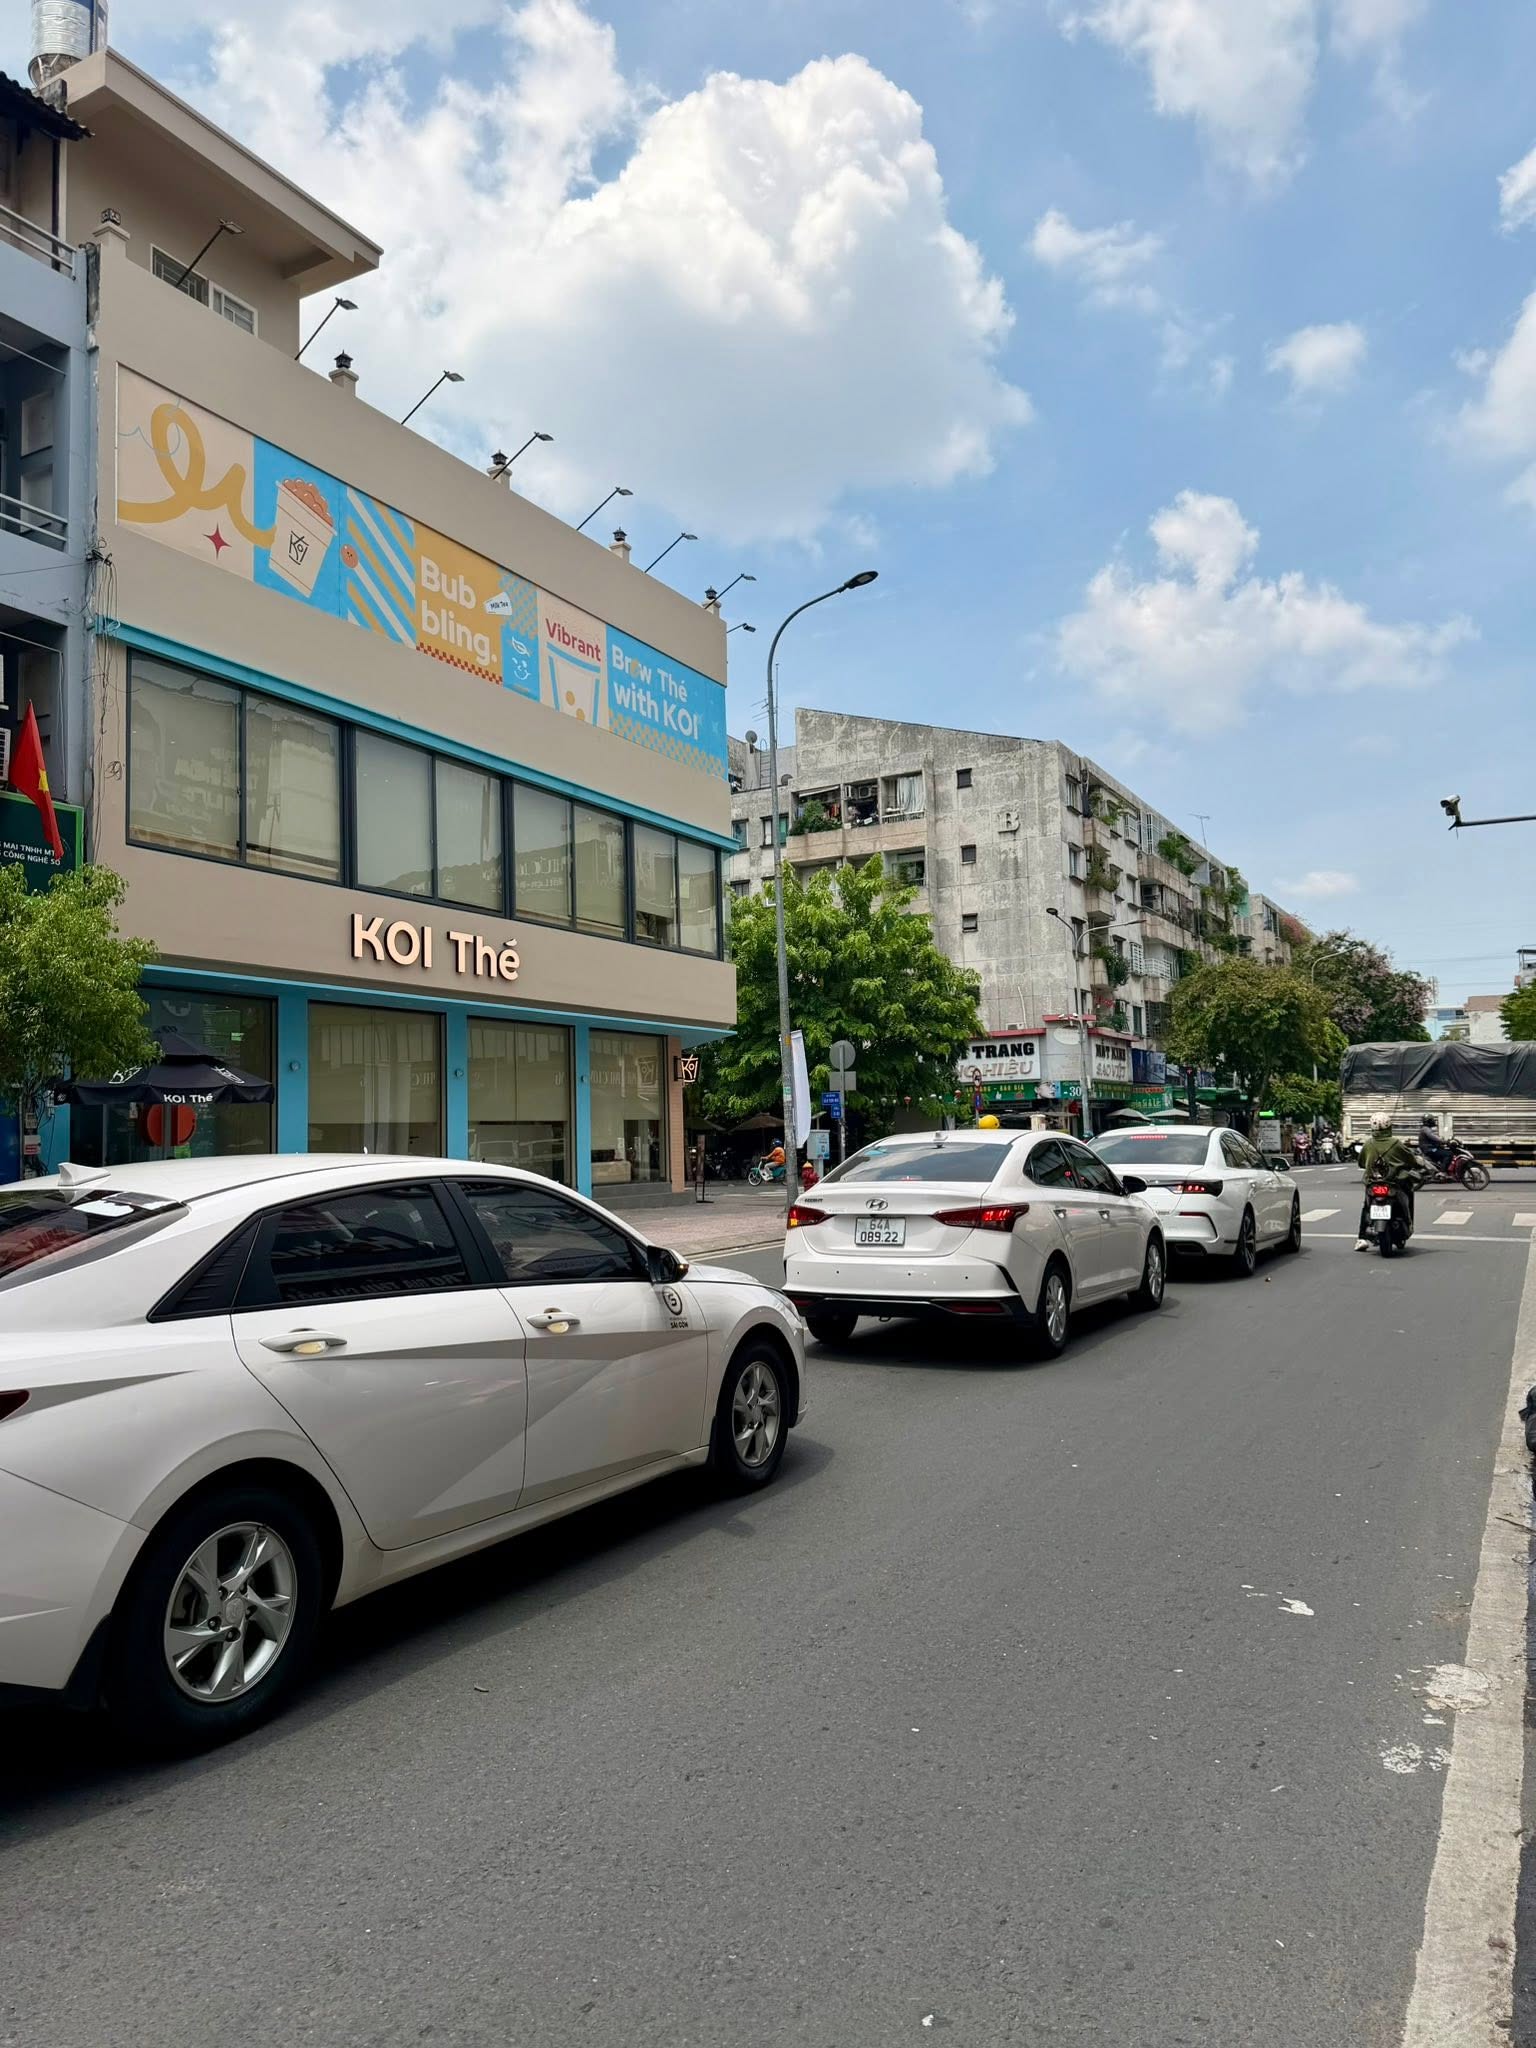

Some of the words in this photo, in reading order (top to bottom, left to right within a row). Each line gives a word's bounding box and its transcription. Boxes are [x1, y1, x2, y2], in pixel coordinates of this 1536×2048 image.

[420, 554, 477, 610] Bub
[421, 599, 498, 666] bling.
[545, 617, 602, 662] Vibrant
[656, 667, 688, 703] Thé
[613, 680, 660, 723] with
[663, 699, 699, 741] KOI
[3, 850, 25, 860] CÔNG
[20, 844, 42, 855] TNHH
[351, 913, 432, 968] KOI
[446, 930, 520, 981] Thé
[972, 1042, 1035, 1060] TRANG
[163, 1093, 186, 1104] KOI
[190, 1092, 213, 1104] Thé
[860, 1231, 898, 1243] 089.22
[869, 1219, 890, 1230] 64A
